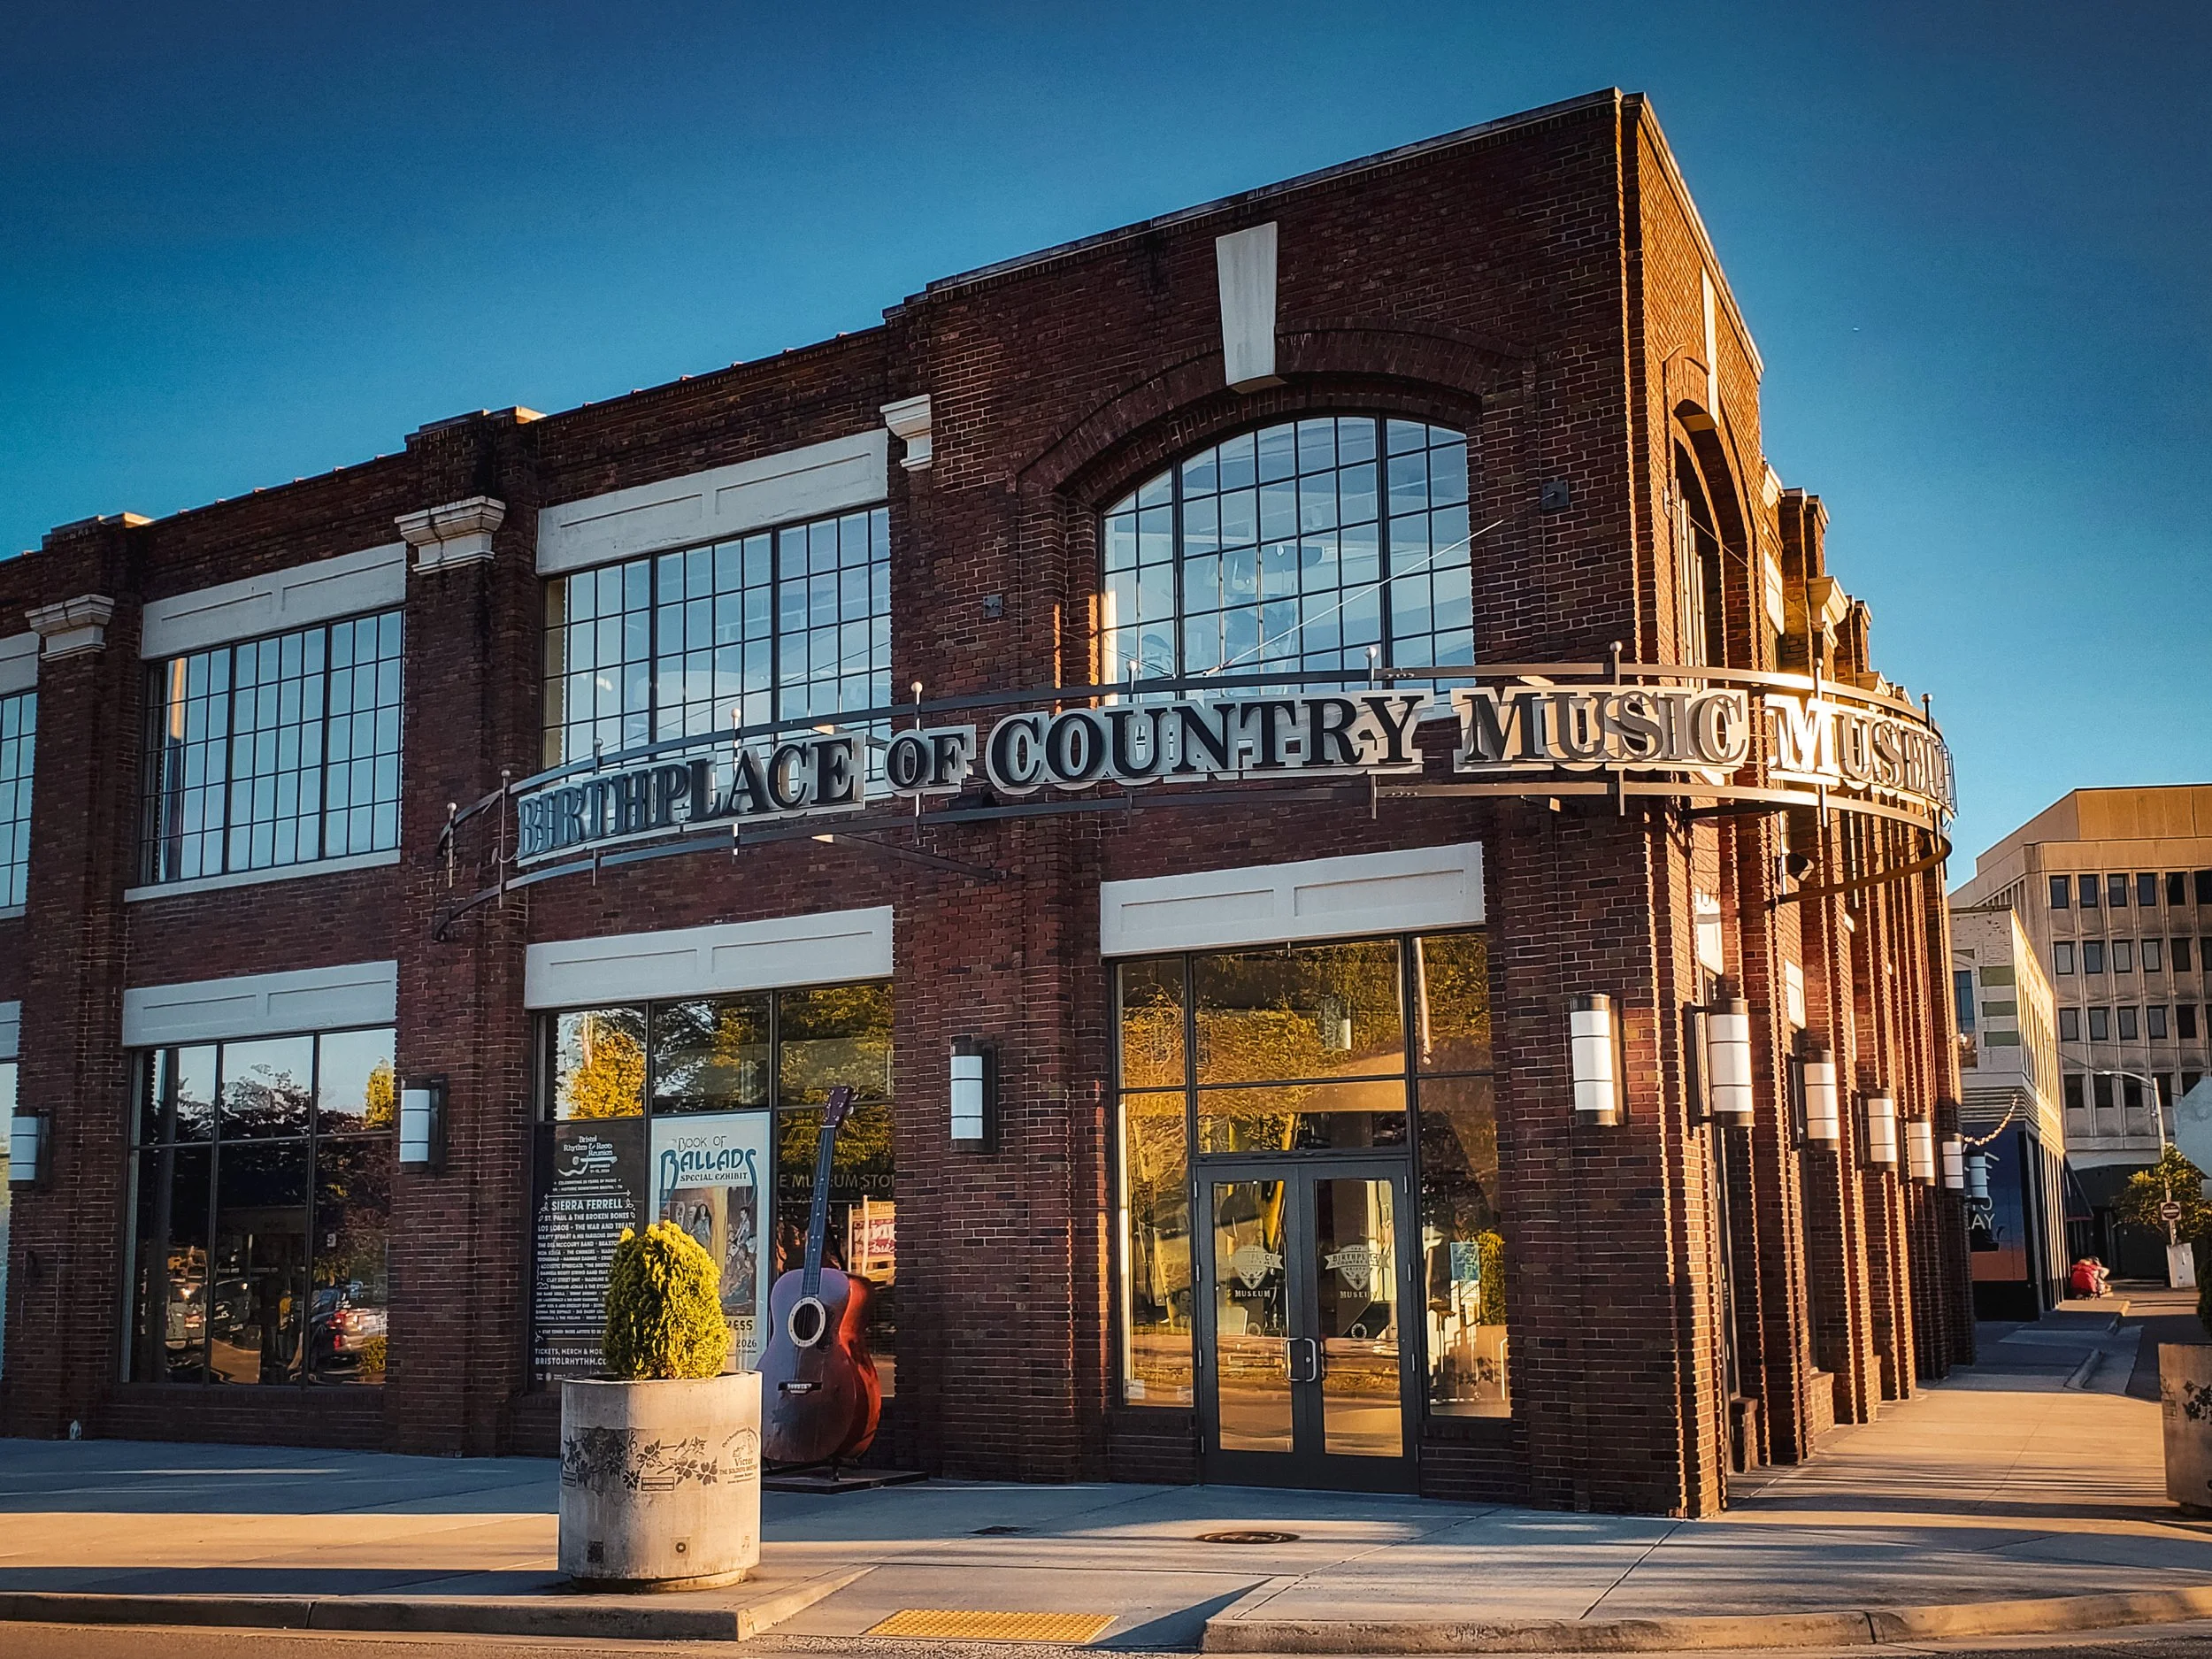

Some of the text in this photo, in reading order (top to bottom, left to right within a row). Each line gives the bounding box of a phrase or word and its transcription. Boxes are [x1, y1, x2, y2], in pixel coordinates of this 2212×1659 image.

[518, 735, 856, 860] BIRTHPLACE
[885, 731, 968, 791] OF
[990, 695, 1425, 787] COUNTRY
[1460, 689, 1747, 764] MUSIC
[680, 1171, 749, 1182] SPECIAL EXHIBIT
[792, 1174, 857, 1187] MUUM
[863, 1174, 895, 1187] STO
[551, 1198, 623, 1211] SIERRA FERRELL
[1968, 1213, 1995, 1230] AY
[549, 1224, 569, 1233] LOBOS
[1234, 1289, 1271, 1298] MUSEUM
[736, 1339, 757, 1348] 2026
